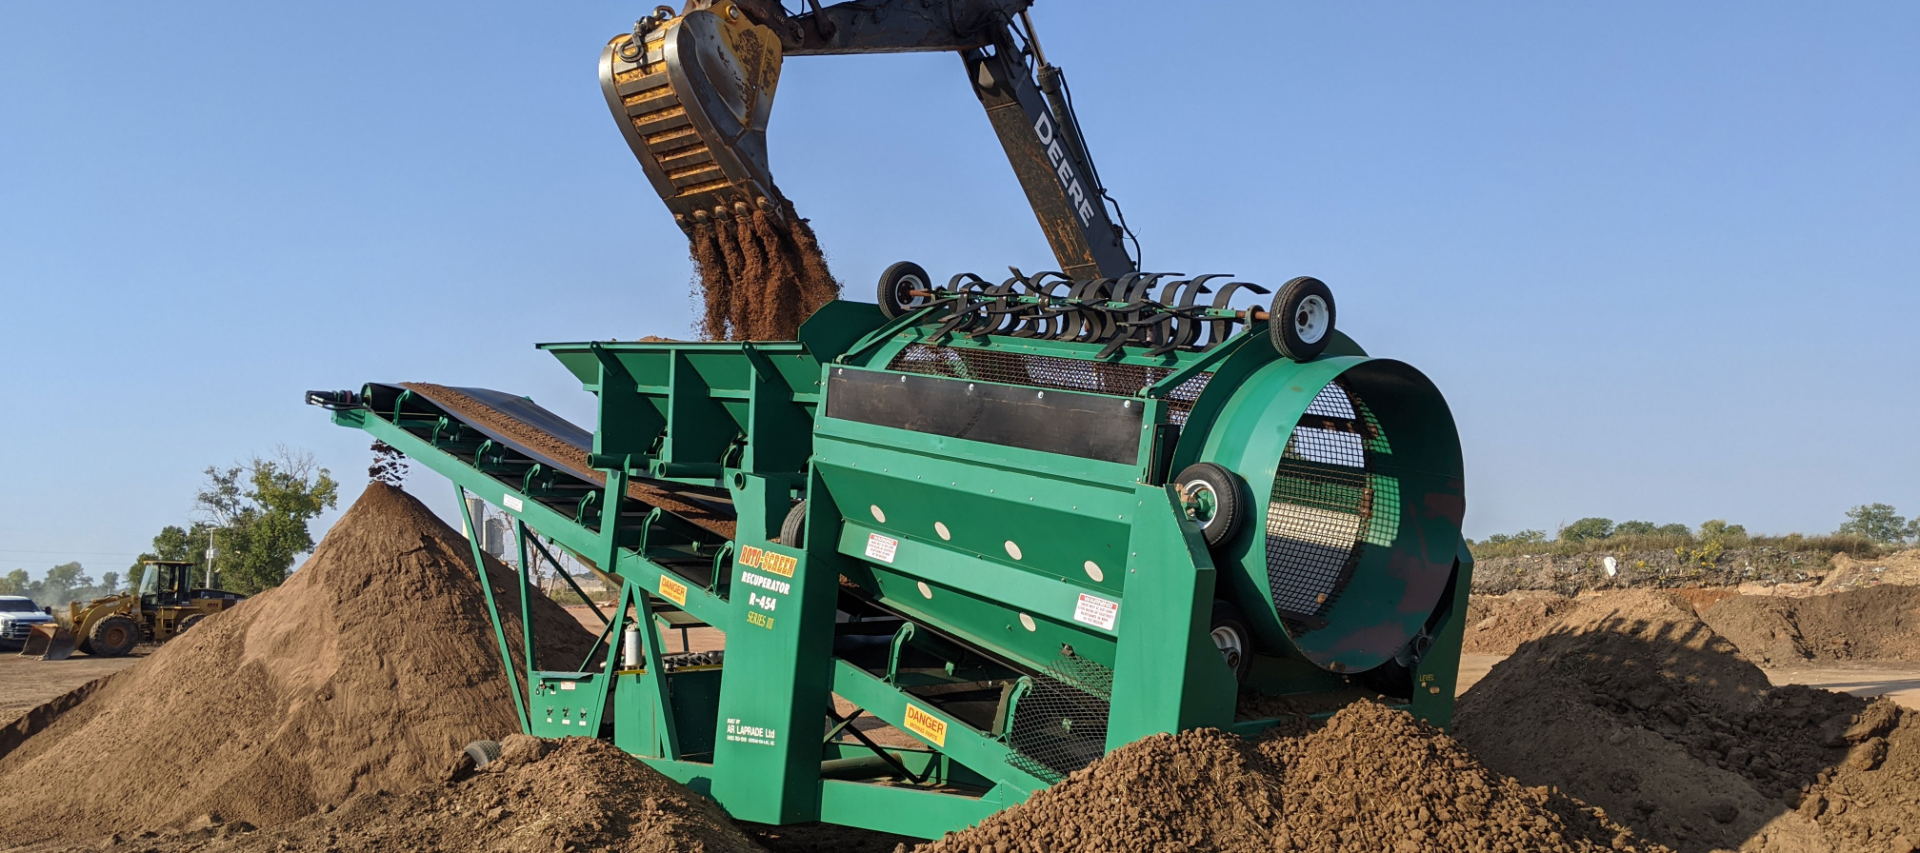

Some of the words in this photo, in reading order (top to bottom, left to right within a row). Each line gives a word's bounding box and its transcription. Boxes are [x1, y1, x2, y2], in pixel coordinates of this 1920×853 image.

[1034, 111, 1095, 228] DEERE
[739, 545, 797, 578] ROTO-SCREEN
[662, 577, 685, 597] DANGER
[741, 571, 790, 595] RECUPERATOR
[749, 592, 777, 611] R-454
[747, 611, 767, 627] SERIES
[908, 707, 944, 735] DANGER
[727, 725, 735, 734] AR
[737, 725, 763, 737] LAPRADE
[765, 729, 775, 738] Ltd
[909, 722, 925, 733] MOVING
[925, 730, 937, 741] PARTS
